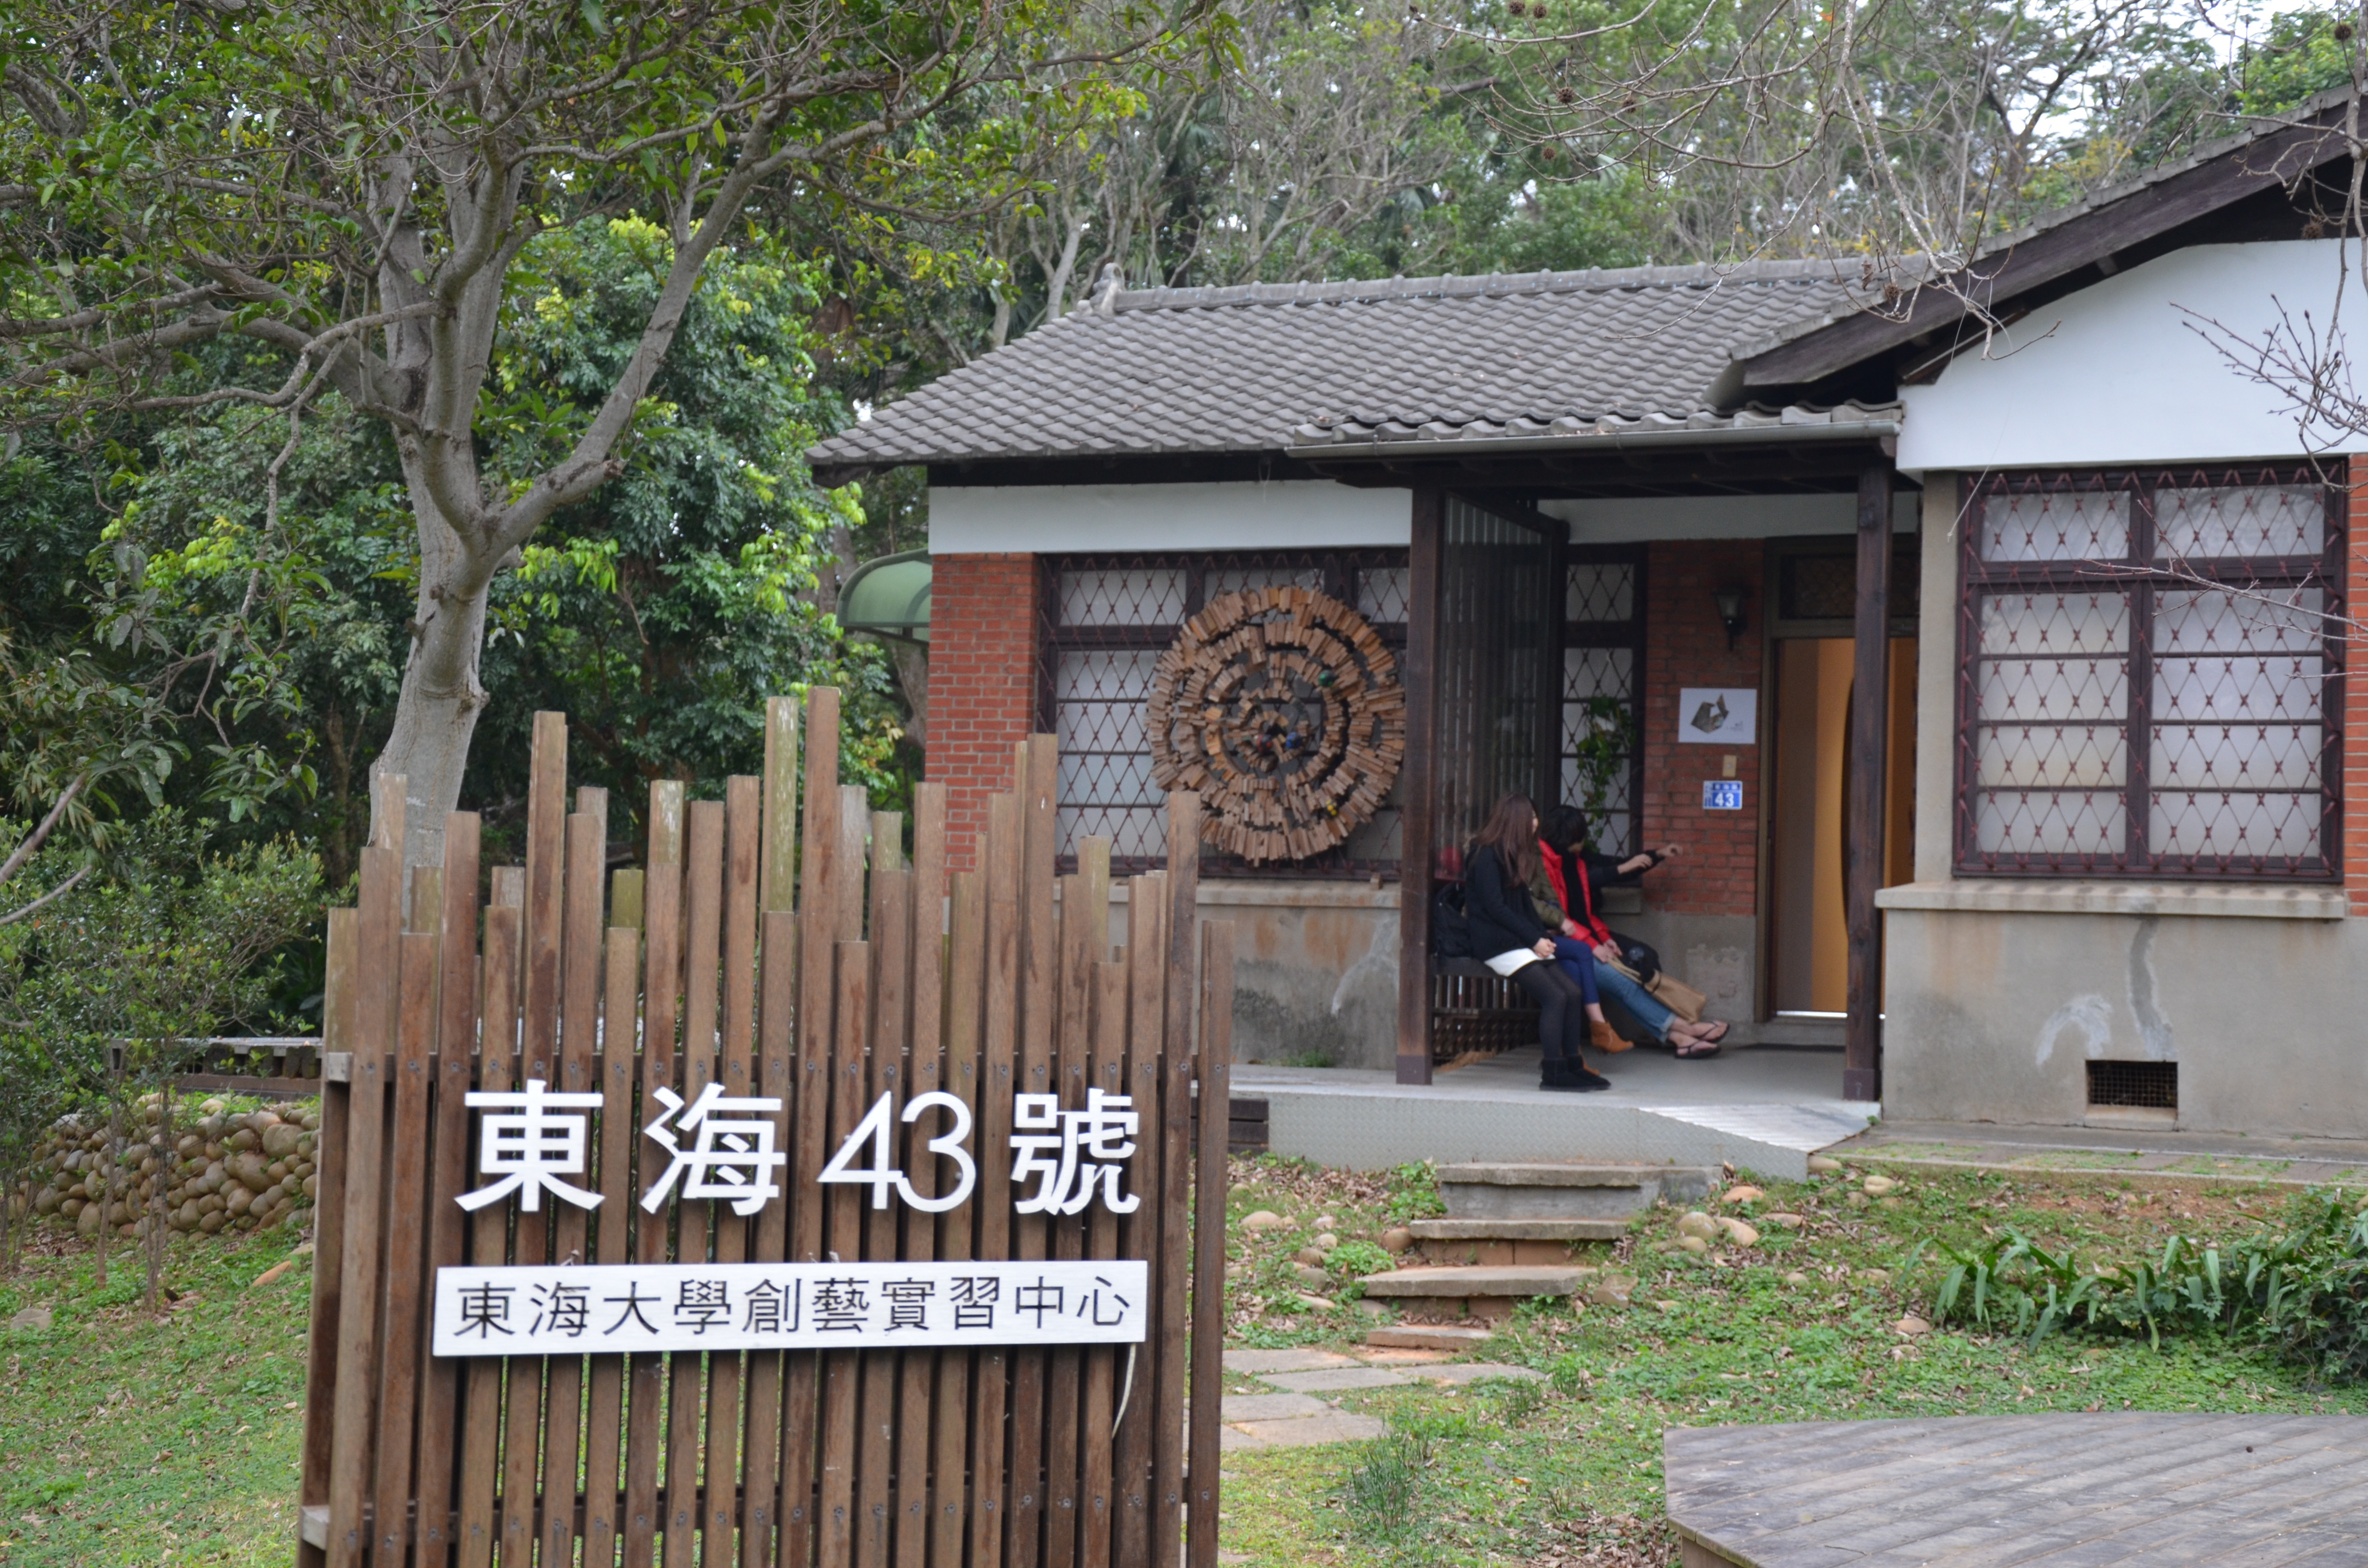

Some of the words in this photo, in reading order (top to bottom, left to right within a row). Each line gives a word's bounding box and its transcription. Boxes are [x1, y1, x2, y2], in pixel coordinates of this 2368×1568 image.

[1715, 792, 1734, 807] 43
[455, 1079, 1140, 1216] 東海43號
[454, 1275, 1130, 1338] 東海大學創藝實習中心
